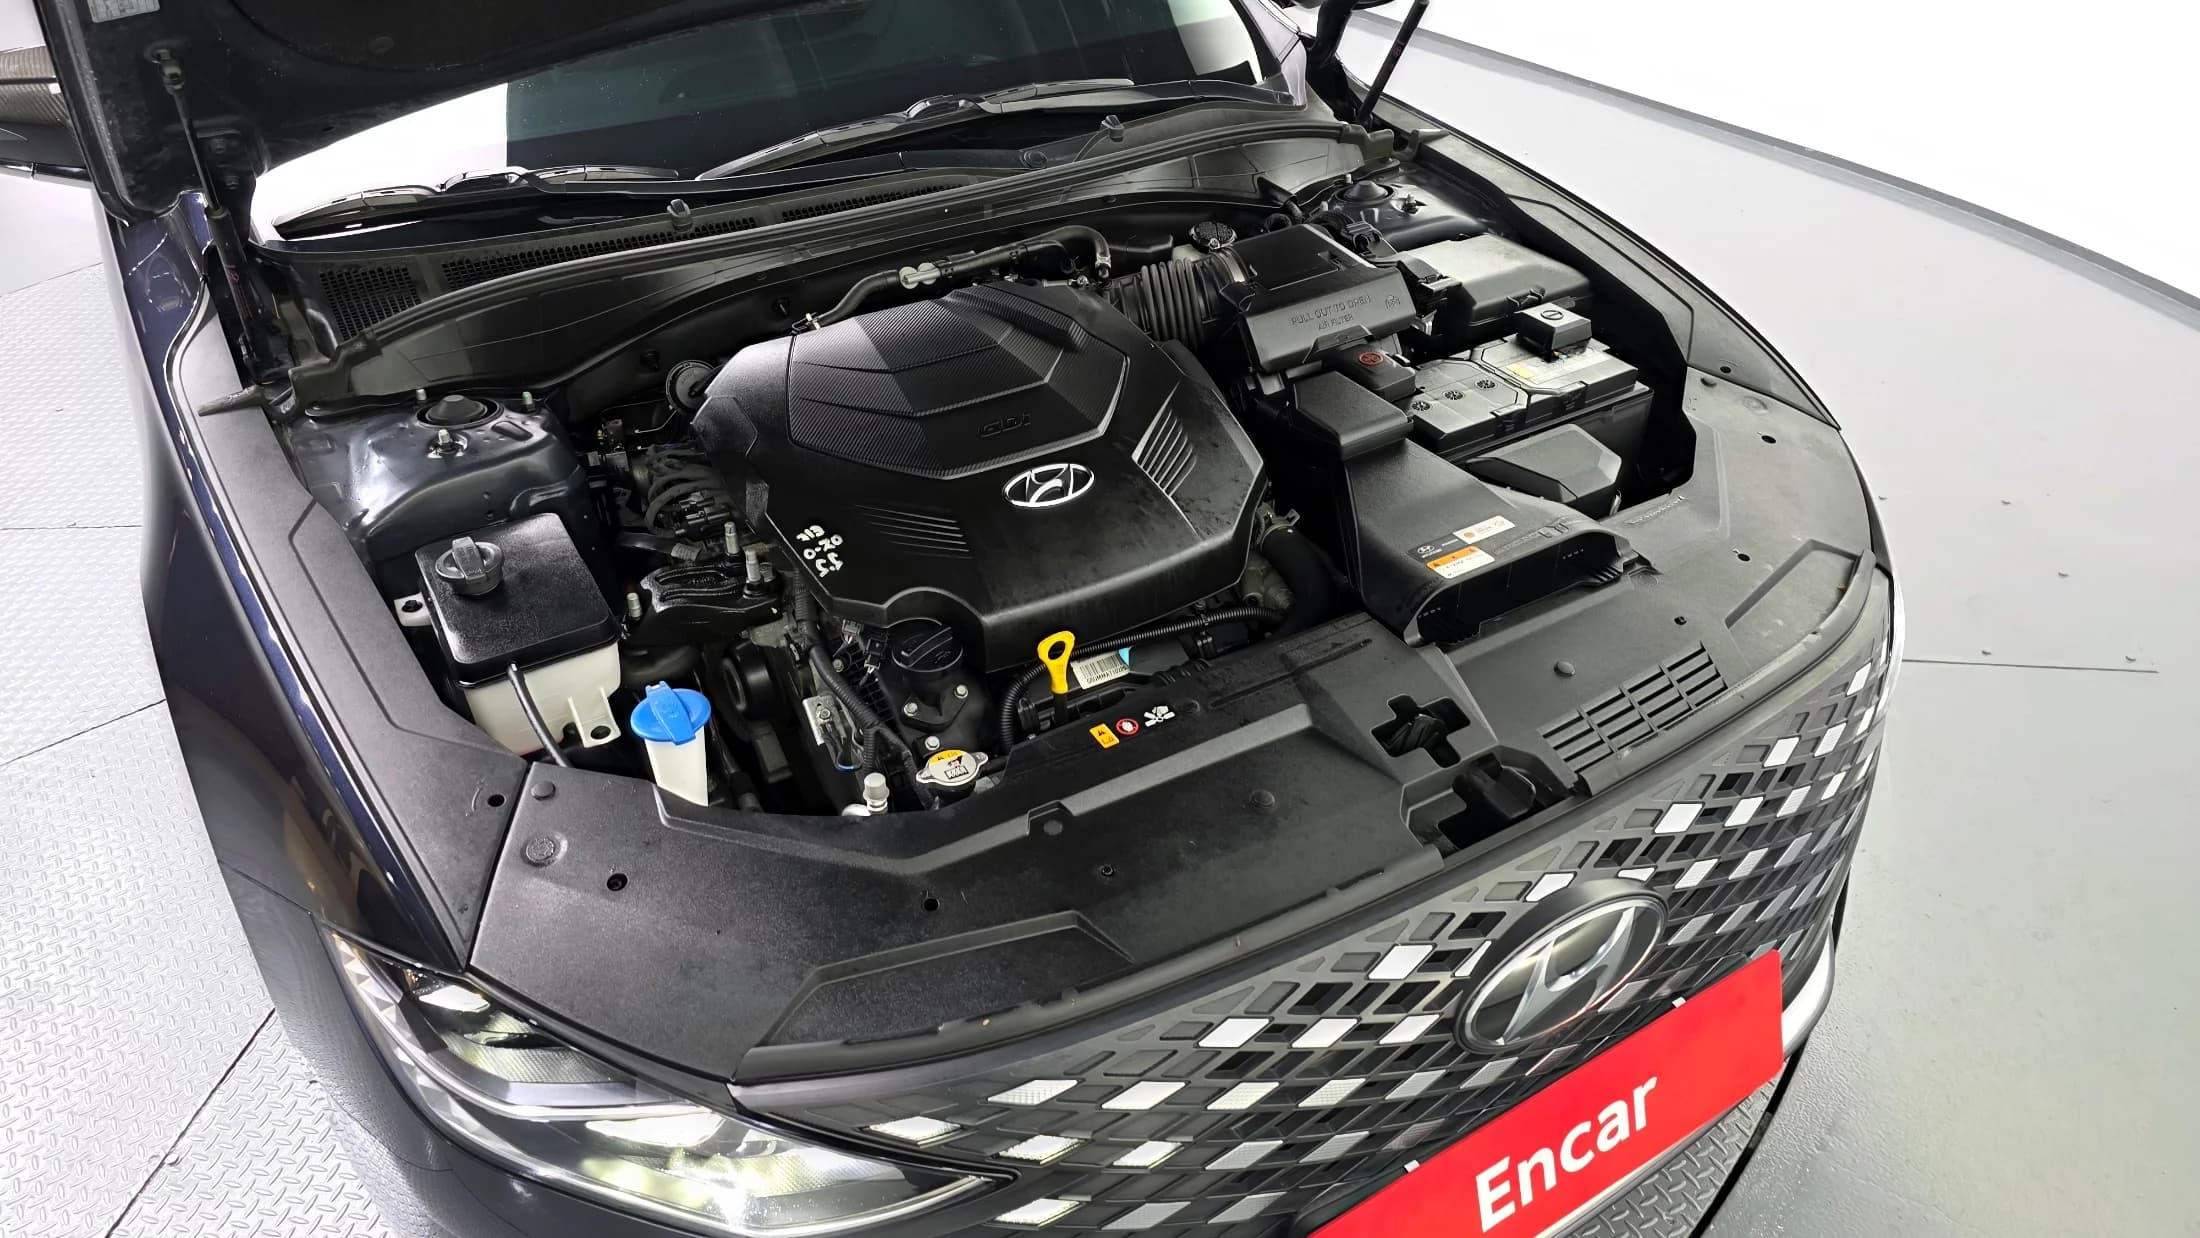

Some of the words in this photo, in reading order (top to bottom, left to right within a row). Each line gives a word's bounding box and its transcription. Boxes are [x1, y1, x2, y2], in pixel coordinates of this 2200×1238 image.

[1314, 304, 1333, 319] OUT
[1332, 301, 1346, 313] TO
[1475, 1076, 1658, 1233] Encar
